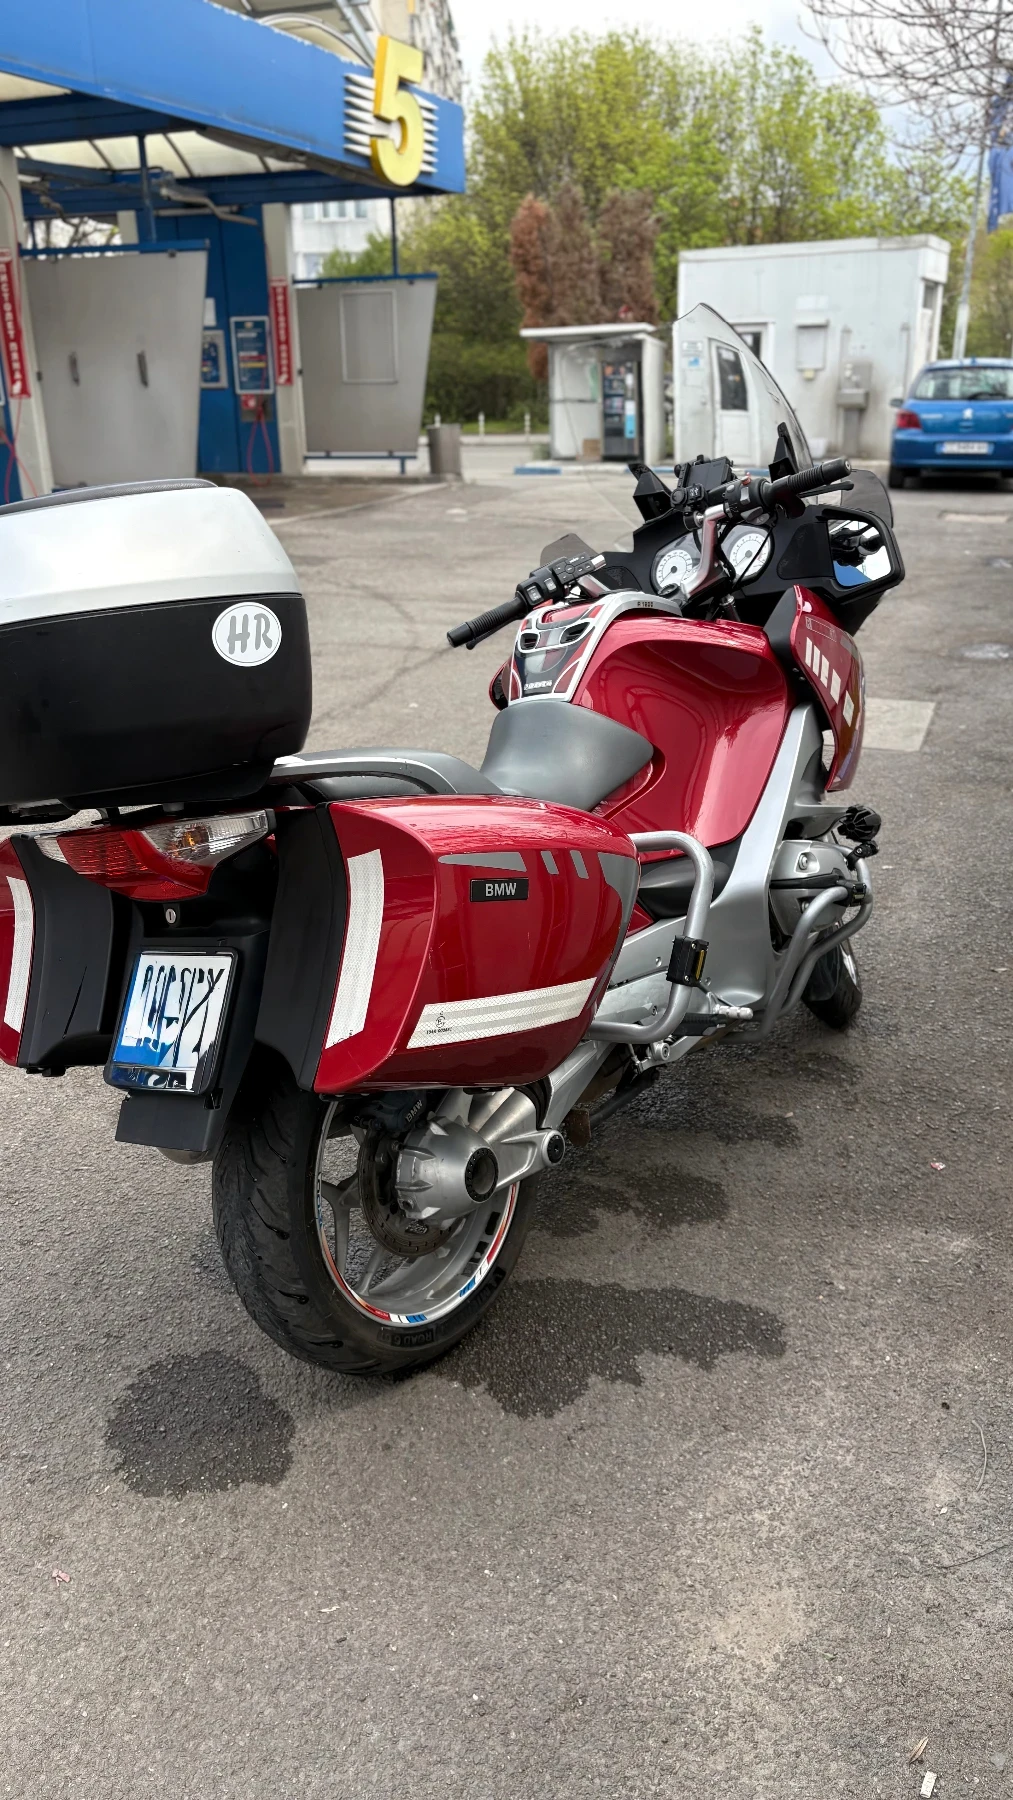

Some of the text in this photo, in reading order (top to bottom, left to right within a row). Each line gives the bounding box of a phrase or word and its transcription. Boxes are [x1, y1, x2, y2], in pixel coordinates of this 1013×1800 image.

[370, 35, 424, 186] 5
[227, 613, 273, 655] HR
[485, 882, 517, 896] BMW
[405, 1100, 422, 1122] BMW
[403, 1332, 432, 1345] ROAD
